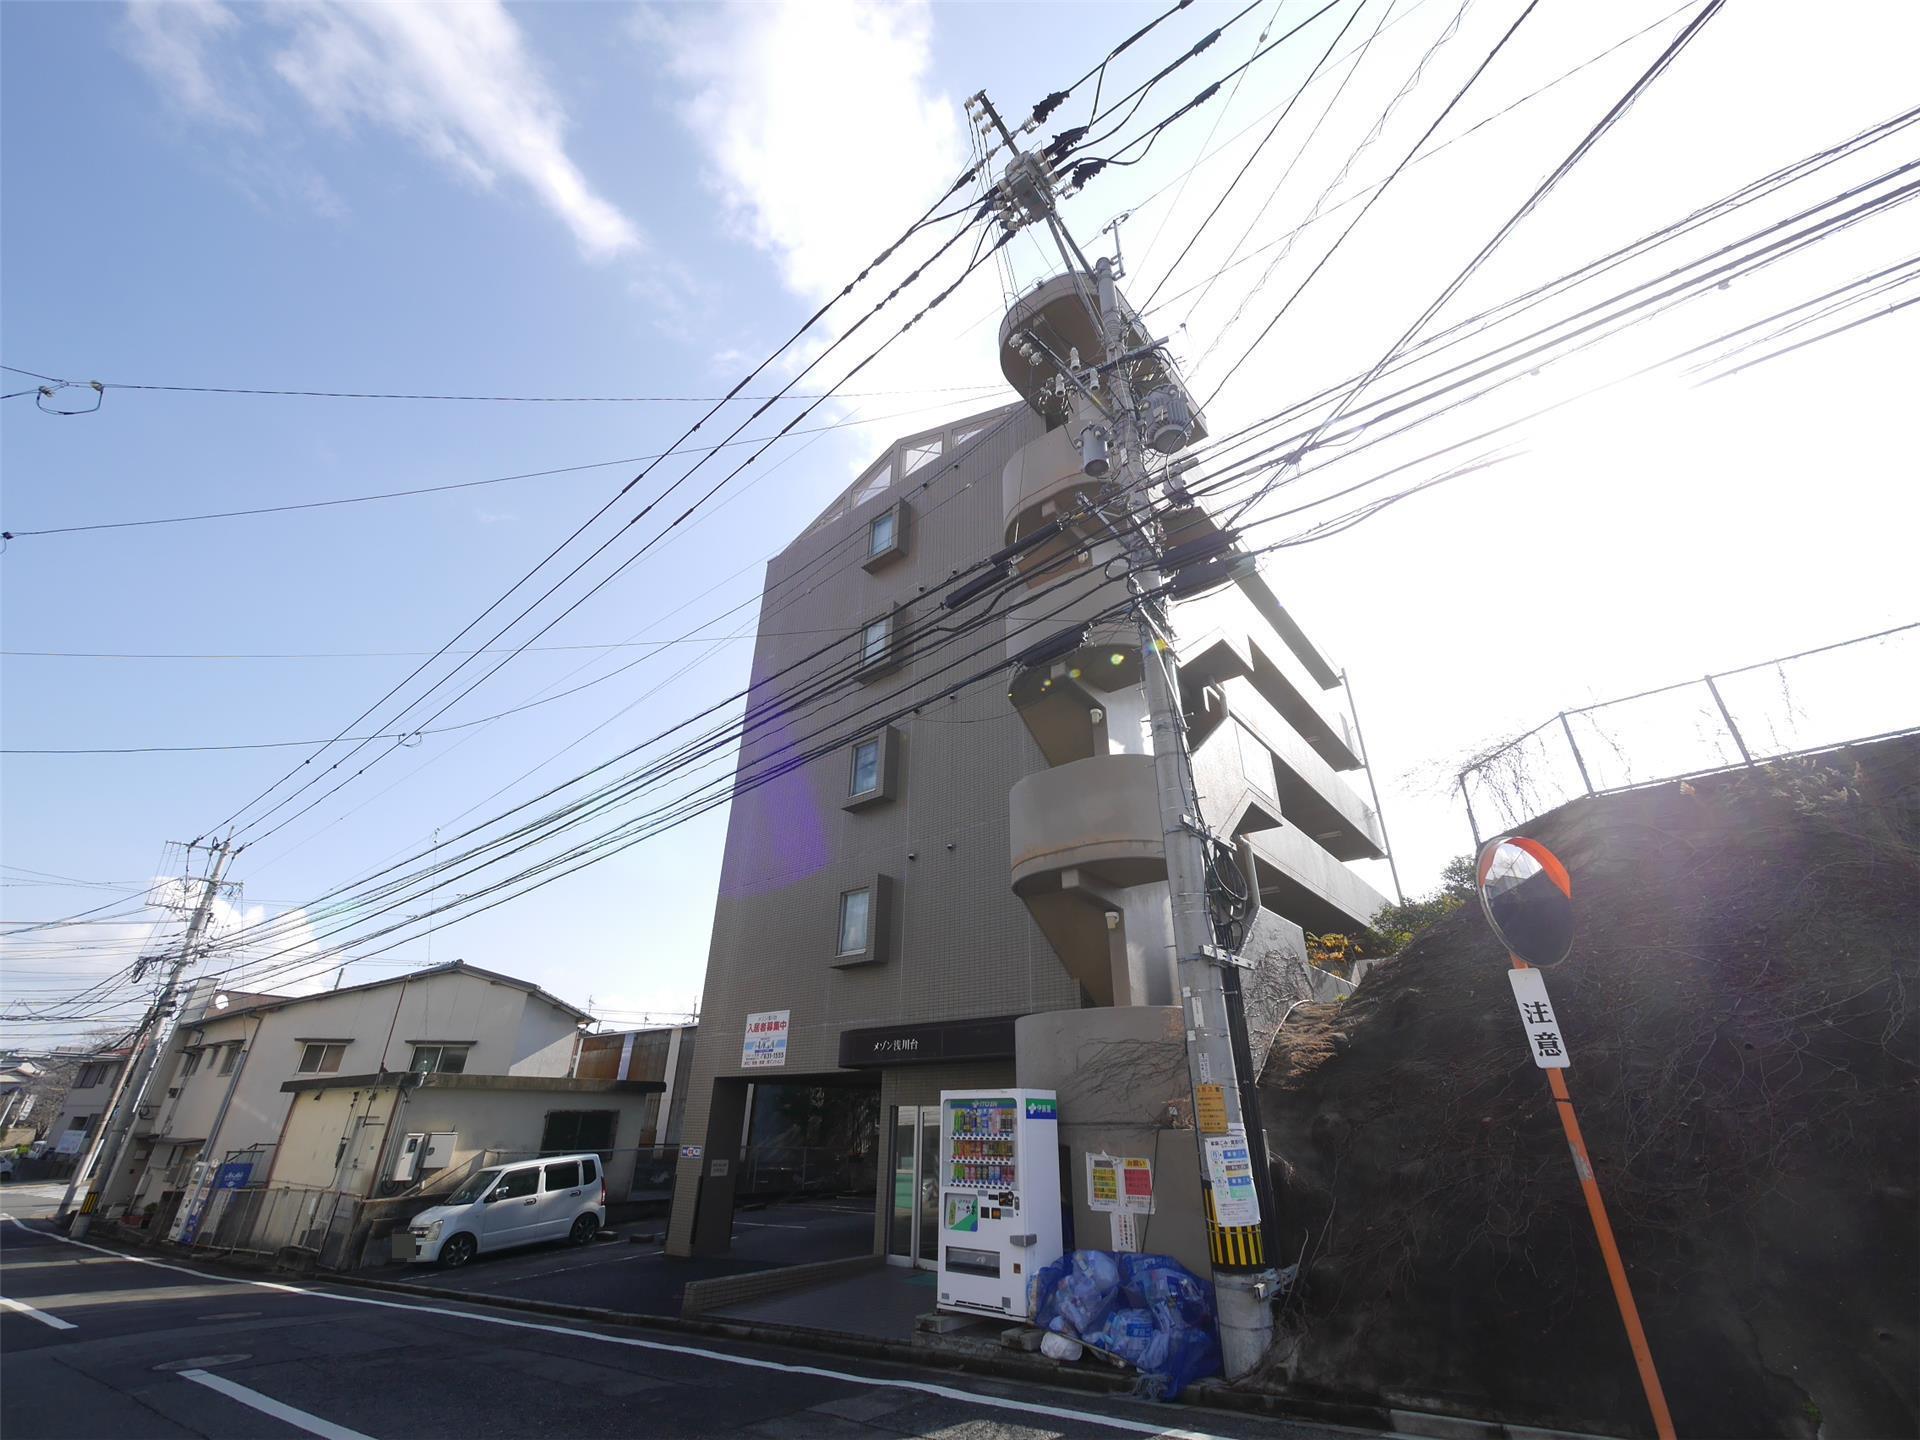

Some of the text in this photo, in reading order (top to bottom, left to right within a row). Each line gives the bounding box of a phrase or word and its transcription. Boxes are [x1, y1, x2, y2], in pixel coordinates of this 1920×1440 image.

[747, 1021, 787, 1033] 入居者募集中
[1523, 1001, 1562, 1057] 注意
[873, 1039, 919, 1051] メゾン浅川台
